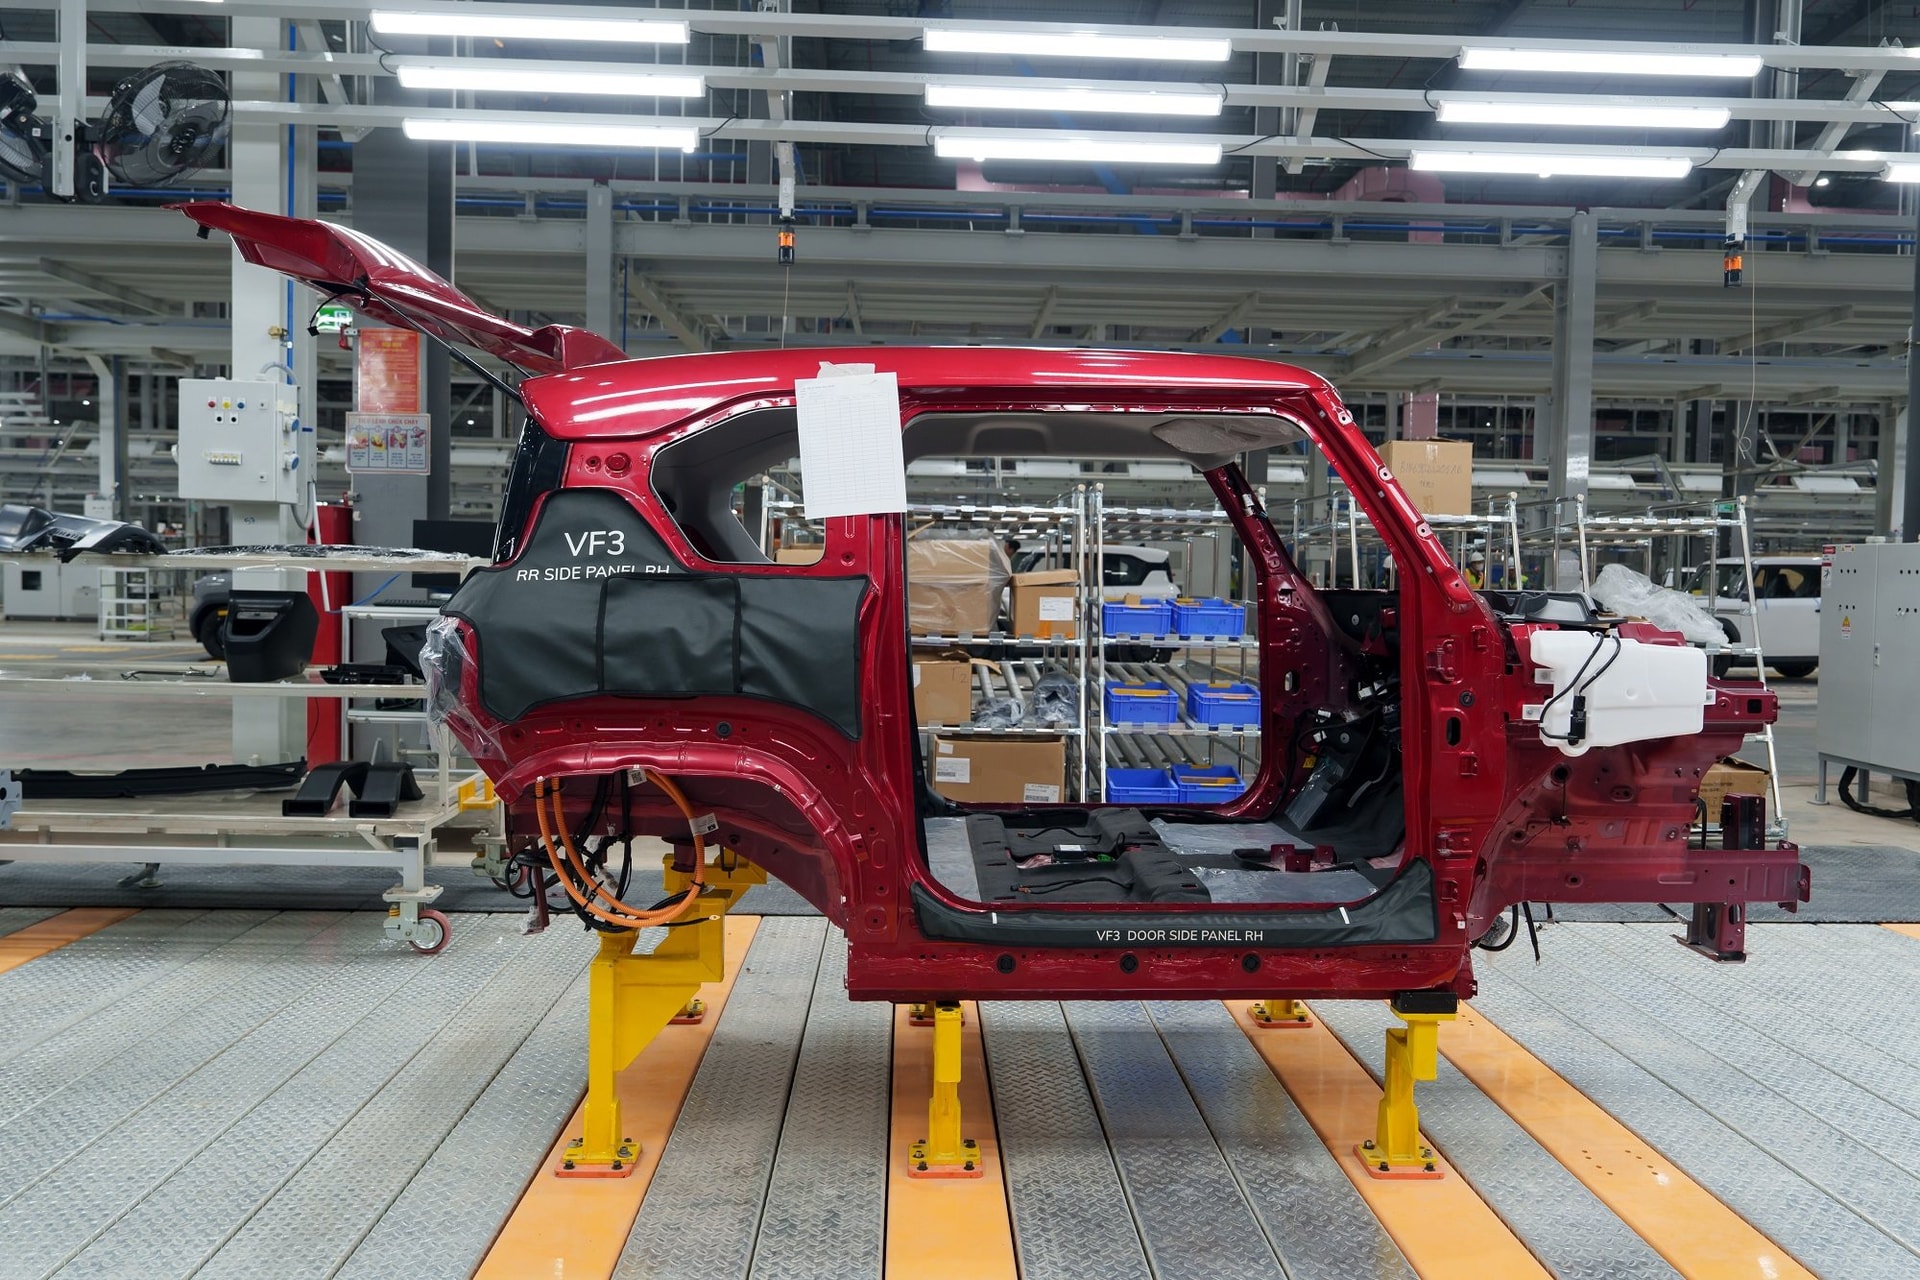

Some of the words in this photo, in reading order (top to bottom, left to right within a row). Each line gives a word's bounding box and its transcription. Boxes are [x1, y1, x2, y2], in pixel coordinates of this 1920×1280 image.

[564, 530, 625, 557] VF3
[516, 568, 540, 582] RR
[544, 566, 582, 581] SIDE
[1096, 930, 1121, 941] VF3
[1127, 930, 1166, 941] DOOR
[1169, 930, 1198, 941] SIDE
[1201, 930, 1242, 941] PANEL
[1245, 930, 1263, 941] RH
